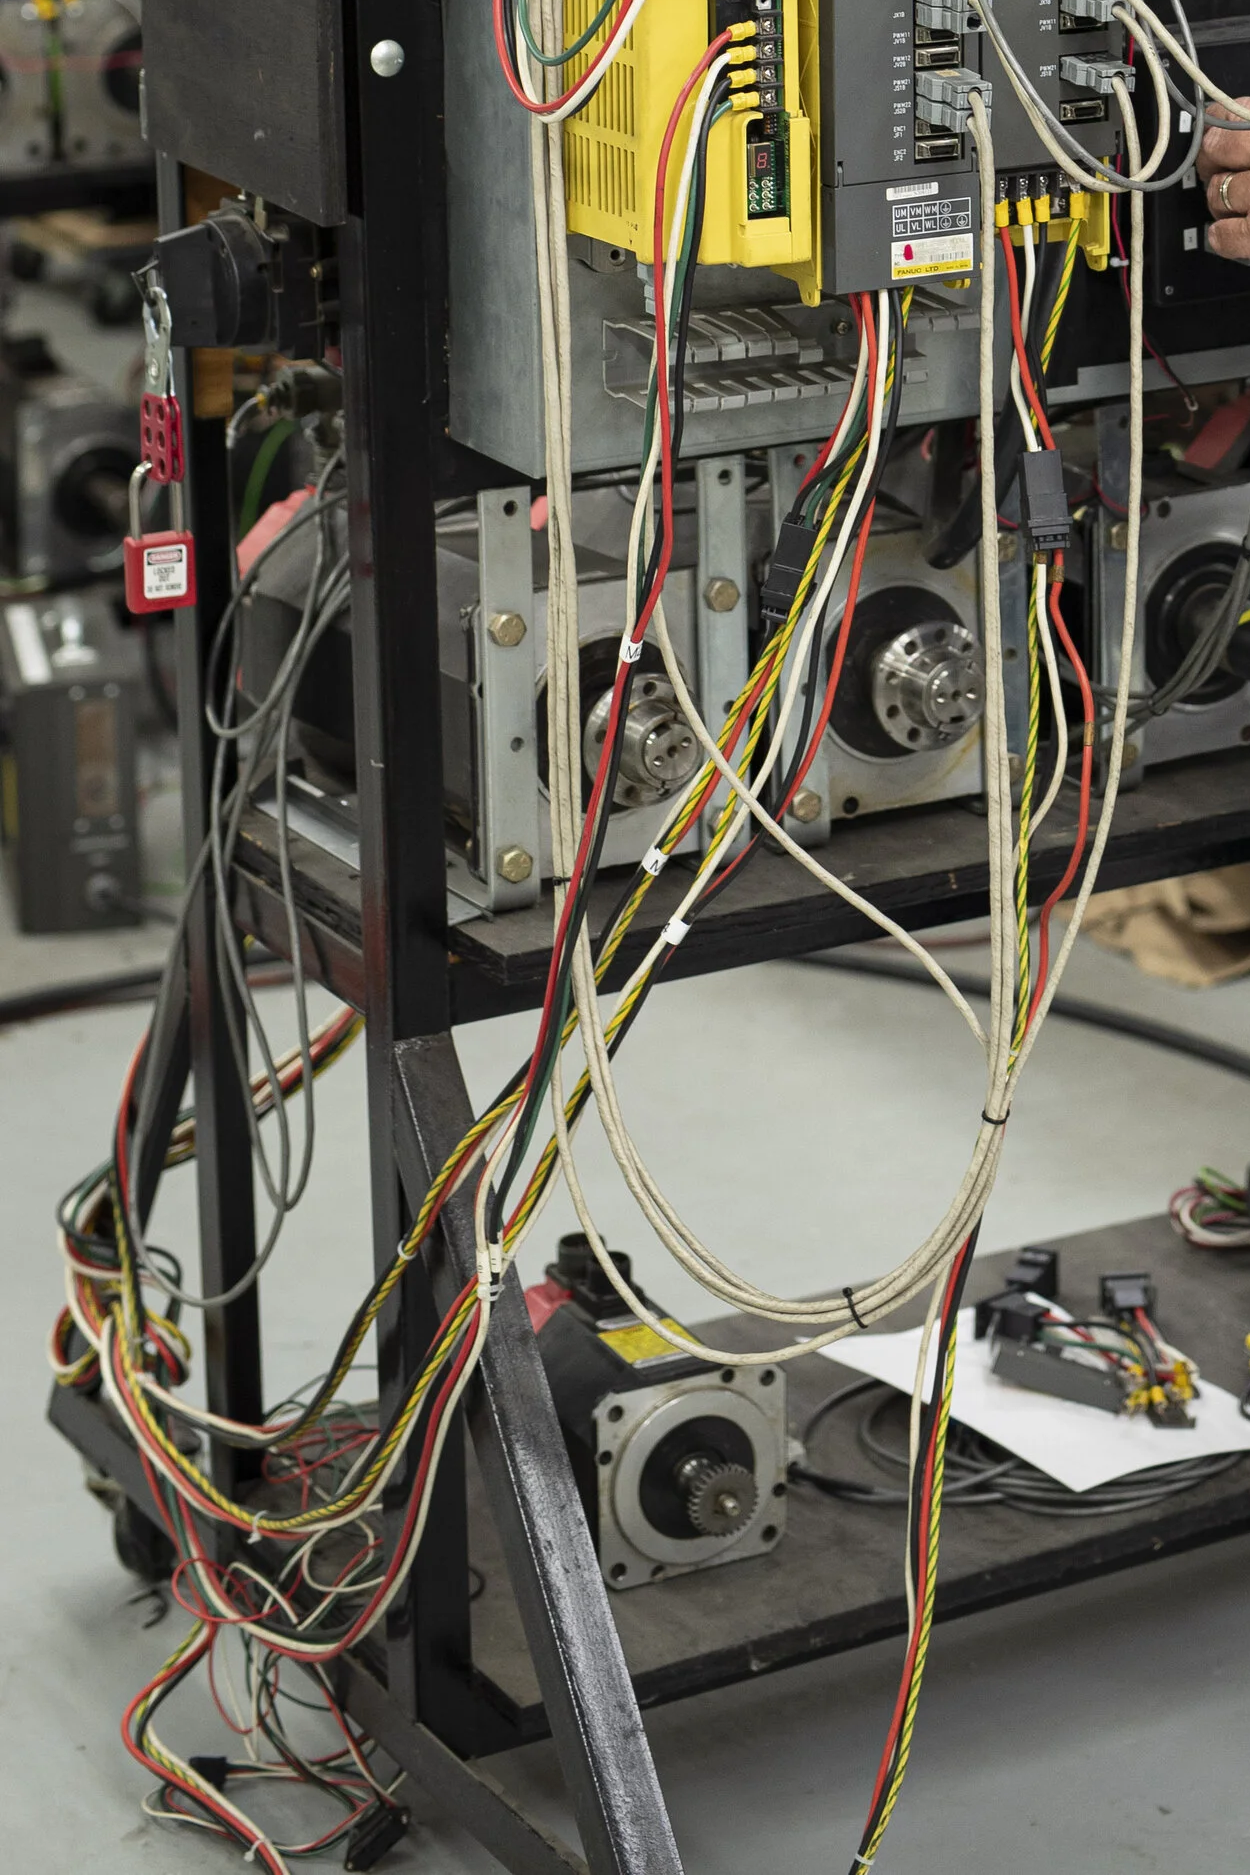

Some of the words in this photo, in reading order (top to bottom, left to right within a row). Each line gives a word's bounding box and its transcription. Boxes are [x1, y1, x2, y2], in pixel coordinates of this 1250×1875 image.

[895, 209, 907, 218] UM
[910, 206, 922, 215] VM
[924, 204, 938, 214] WM
[896, 223, 906, 233] UL
[911, 221, 921, 230] VL
[924, 220, 936, 228] WL
